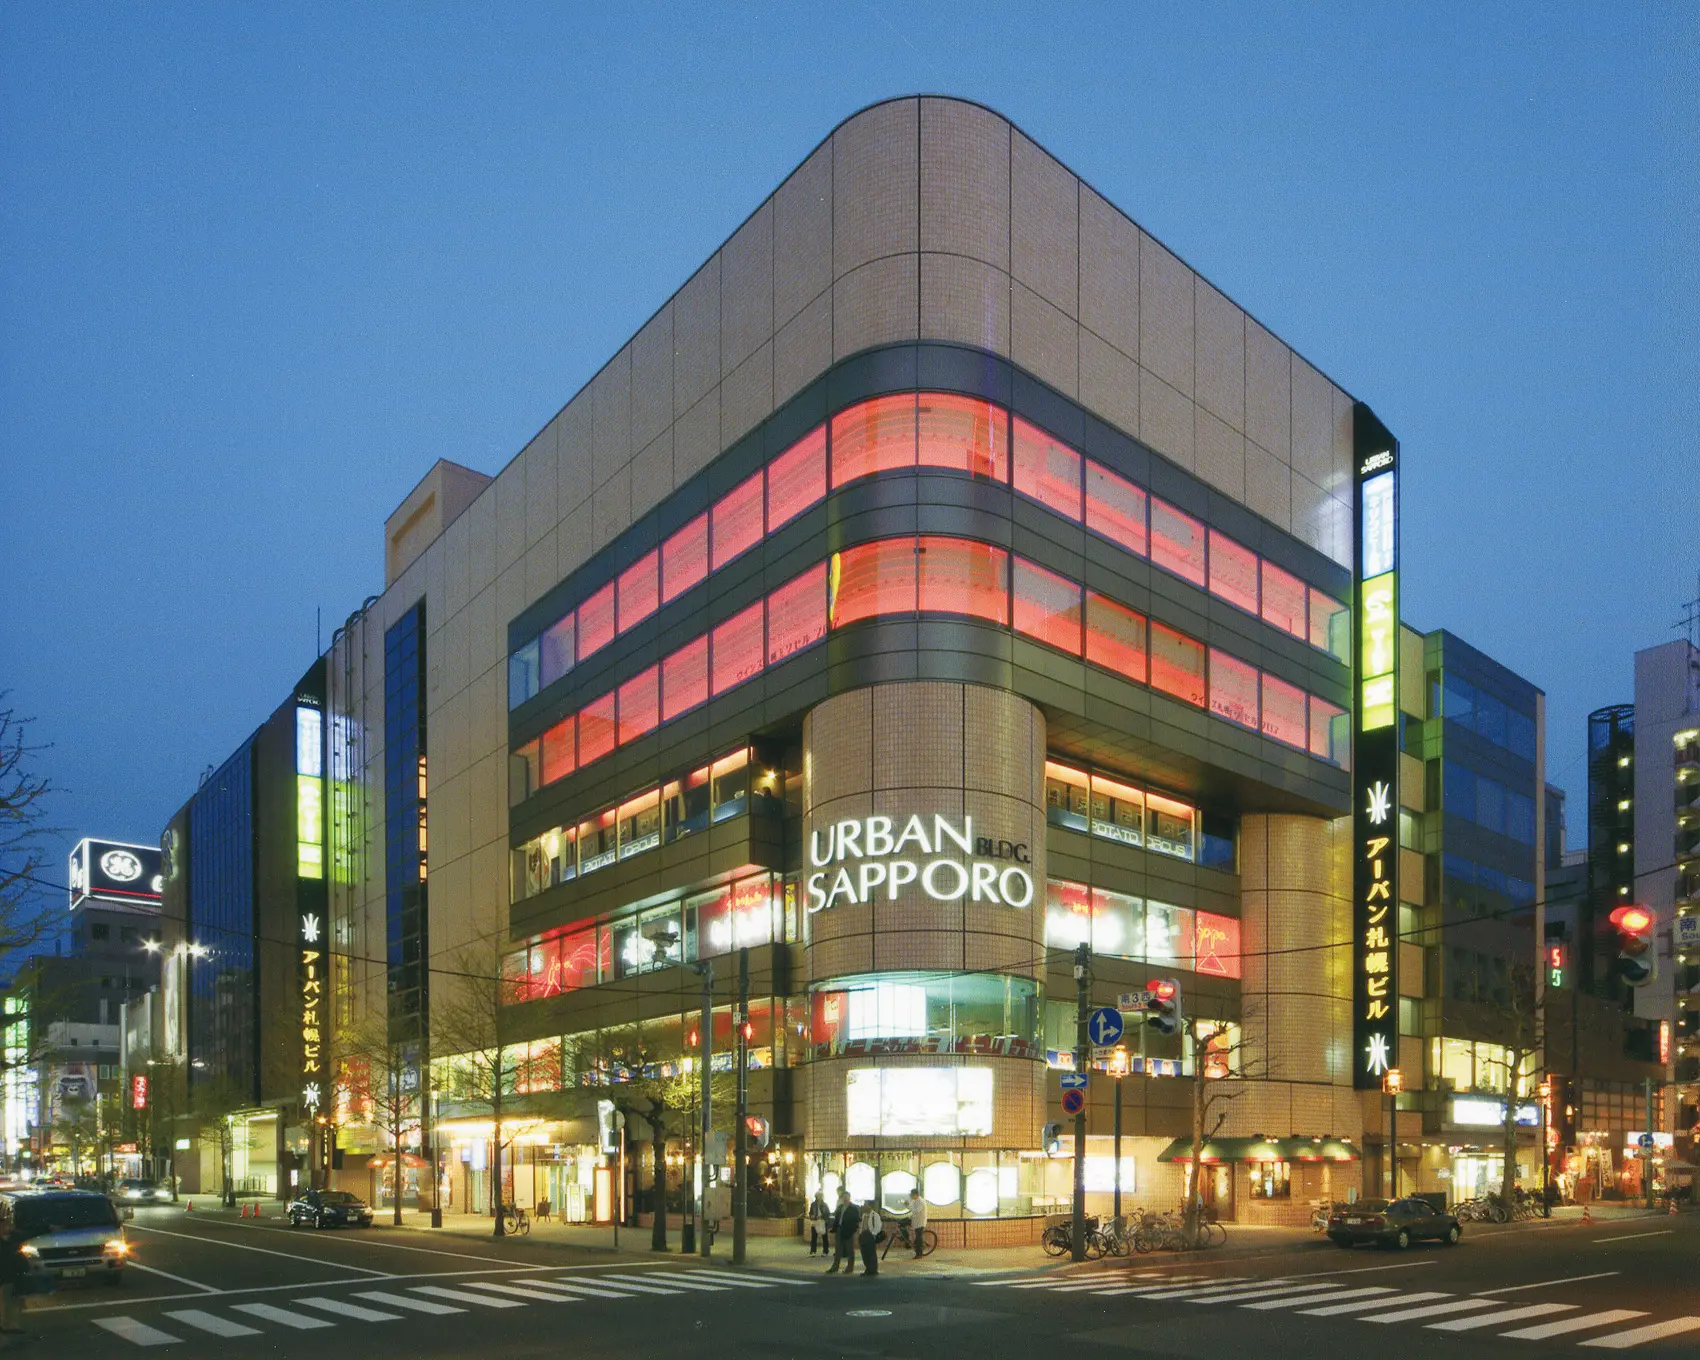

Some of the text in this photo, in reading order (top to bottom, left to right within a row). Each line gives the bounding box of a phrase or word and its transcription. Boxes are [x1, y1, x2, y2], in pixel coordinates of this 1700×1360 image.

[811, 814, 973, 867] URBAN
[807, 858, 1034, 914] SAPPORO
[1365, 836, 1390, 1021] アーバン札幌ビル
[301, 949, 321, 1074] アーバン札幌ビル
